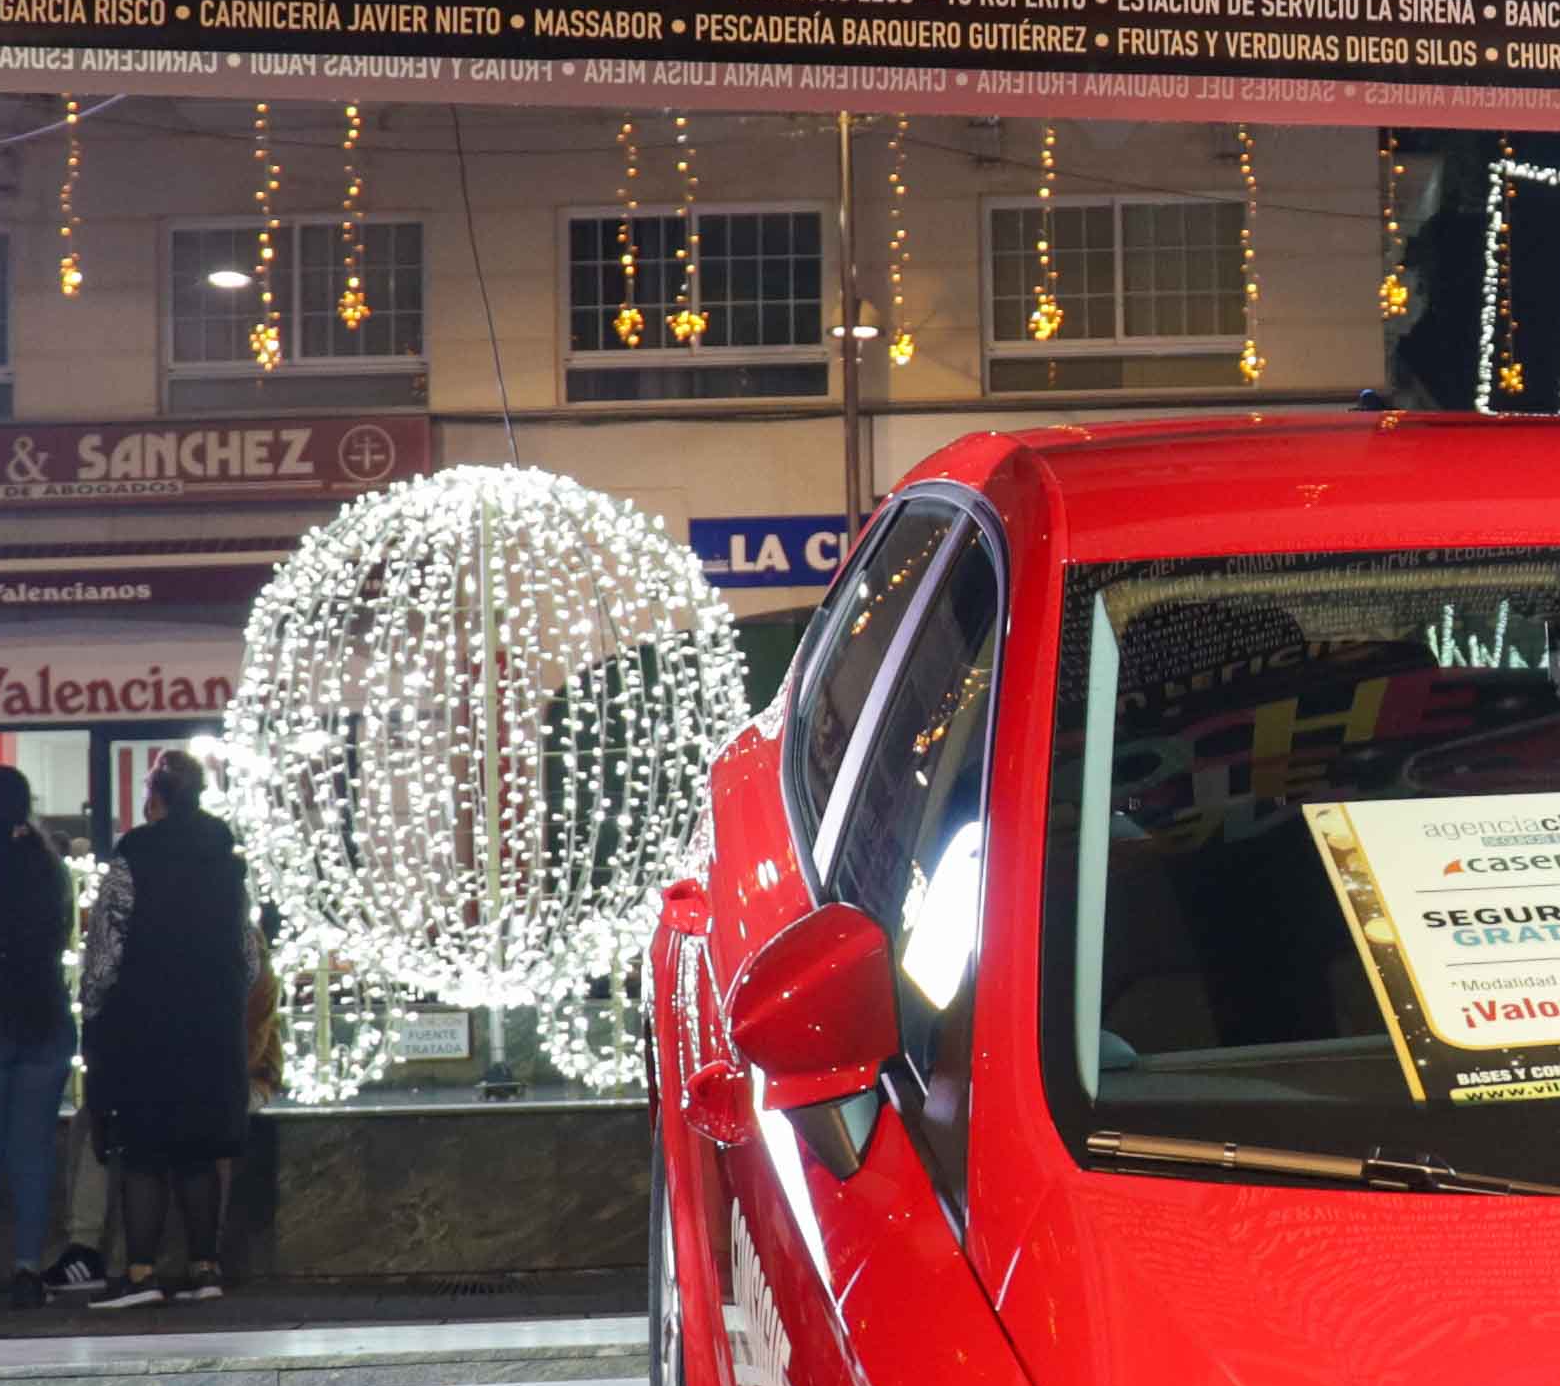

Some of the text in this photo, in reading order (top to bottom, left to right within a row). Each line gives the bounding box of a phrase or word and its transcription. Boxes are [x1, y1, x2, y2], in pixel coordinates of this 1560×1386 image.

[6, 436, 49, 484] &
[77, 428, 314, 480] SANCHEZ
[4, 485, 31, 499] DE
[46, 480, 180, 498] ABOGADOS
[729, 533, 790, 572] LA
[1456, 1067, 1513, 1086] BASES
